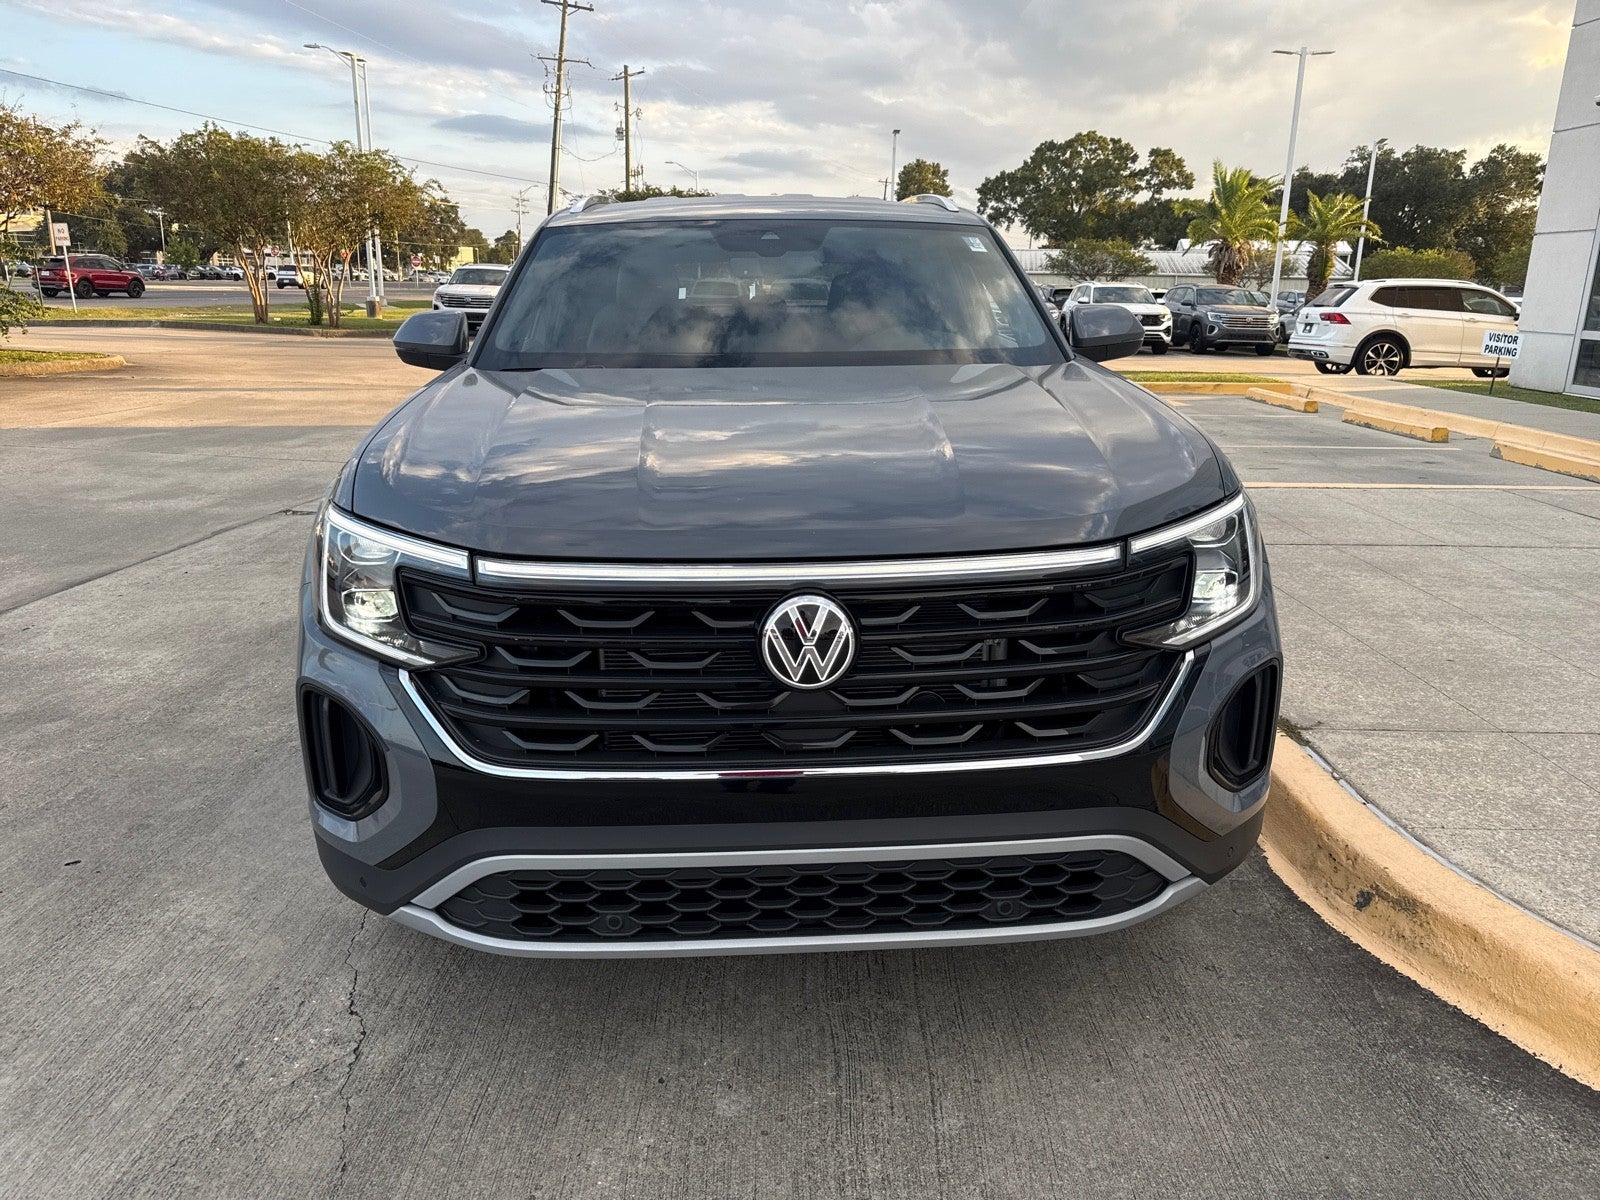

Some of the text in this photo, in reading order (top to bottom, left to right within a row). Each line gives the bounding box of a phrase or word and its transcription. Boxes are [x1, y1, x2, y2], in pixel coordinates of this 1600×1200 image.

[1489, 332, 1519, 345] VISITOR
[1483, 344, 1518, 357] PARKING
[767, 604, 850, 682] VW
